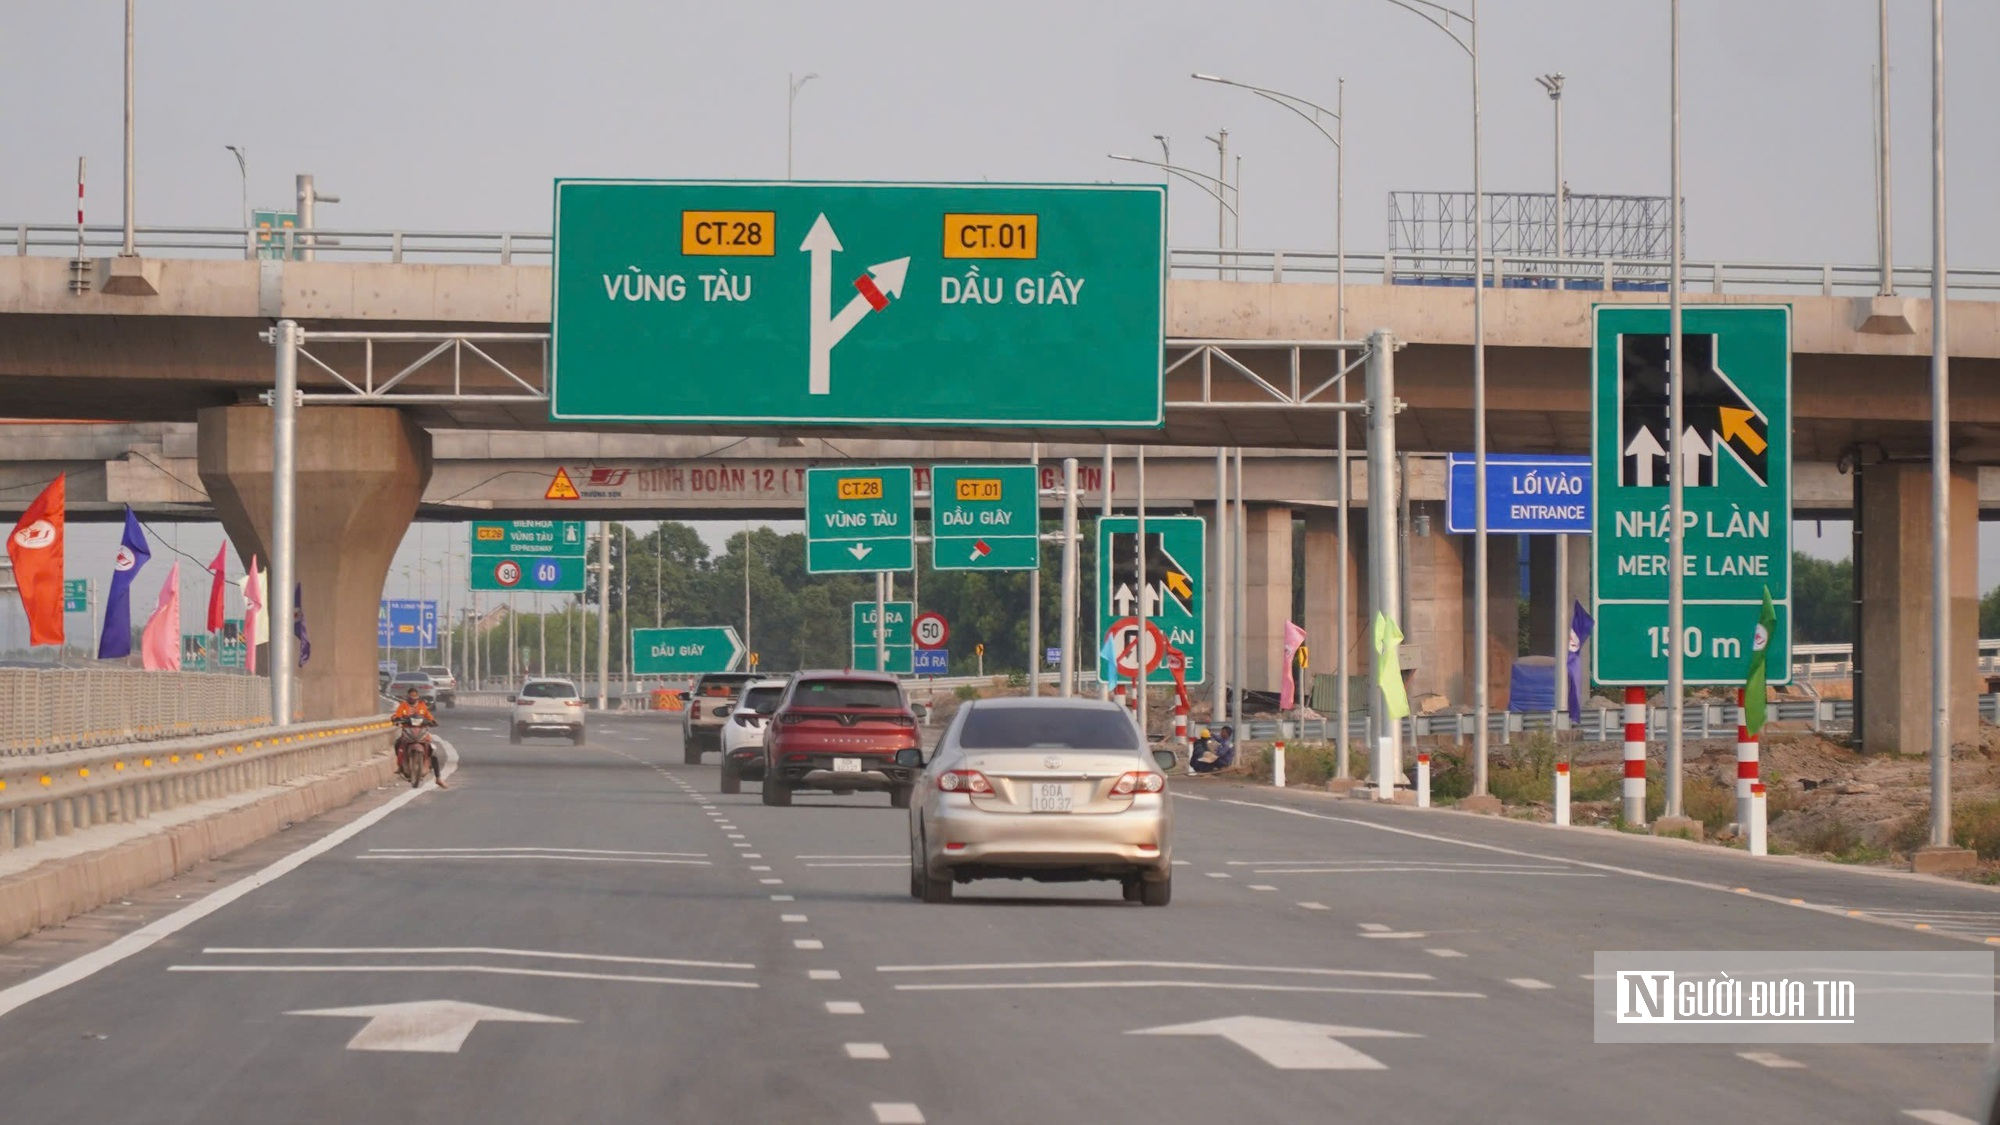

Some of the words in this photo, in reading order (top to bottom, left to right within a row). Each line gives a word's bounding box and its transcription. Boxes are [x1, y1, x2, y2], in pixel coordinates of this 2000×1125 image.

[695, 221, 762, 246] CT.28
[960, 223, 1027, 250] CT.01
[602, 265, 687, 302] VŨNG
[698, 267, 752, 302] TÀU
[941, 264, 1004, 305] DẦU
[1015, 270, 1085, 305] GIÂY
[751, 468, 775, 491] 12
[1513, 469, 1542, 495] LỐI
[1544, 471, 1583, 495] VÀO
[842, 482, 879, 496] CT.28
[960, 483, 998, 497] CT.01
[824, 510, 867, 528] VŨNG
[871, 509, 898, 527] TÀU
[942, 505, 974, 526] DẦU
[979, 508, 1013, 526] GIÂY
[1511, 504, 1586, 520] ENTRANCE
[1706, 503, 1770, 539] LÀN
[510, 530, 534, 542] VŨNG
[536, 531, 553, 542] TÀU
[503, 568, 517, 580] 80
[538, 564, 556, 581] 60
[1617, 555, 1698, 577] MERE
[1706, 555, 1769, 577] LANE
[885, 612, 904, 624] RA
[872, 628, 894, 638] EIT
[922, 623, 939, 639] 50
[679, 643, 705, 657] GIÂY
[1712, 637, 1741, 659] m
[915, 651, 930, 667] LỐI
[932, 655, 947, 667] RA
[1041, 784, 1064, 797] 60A
